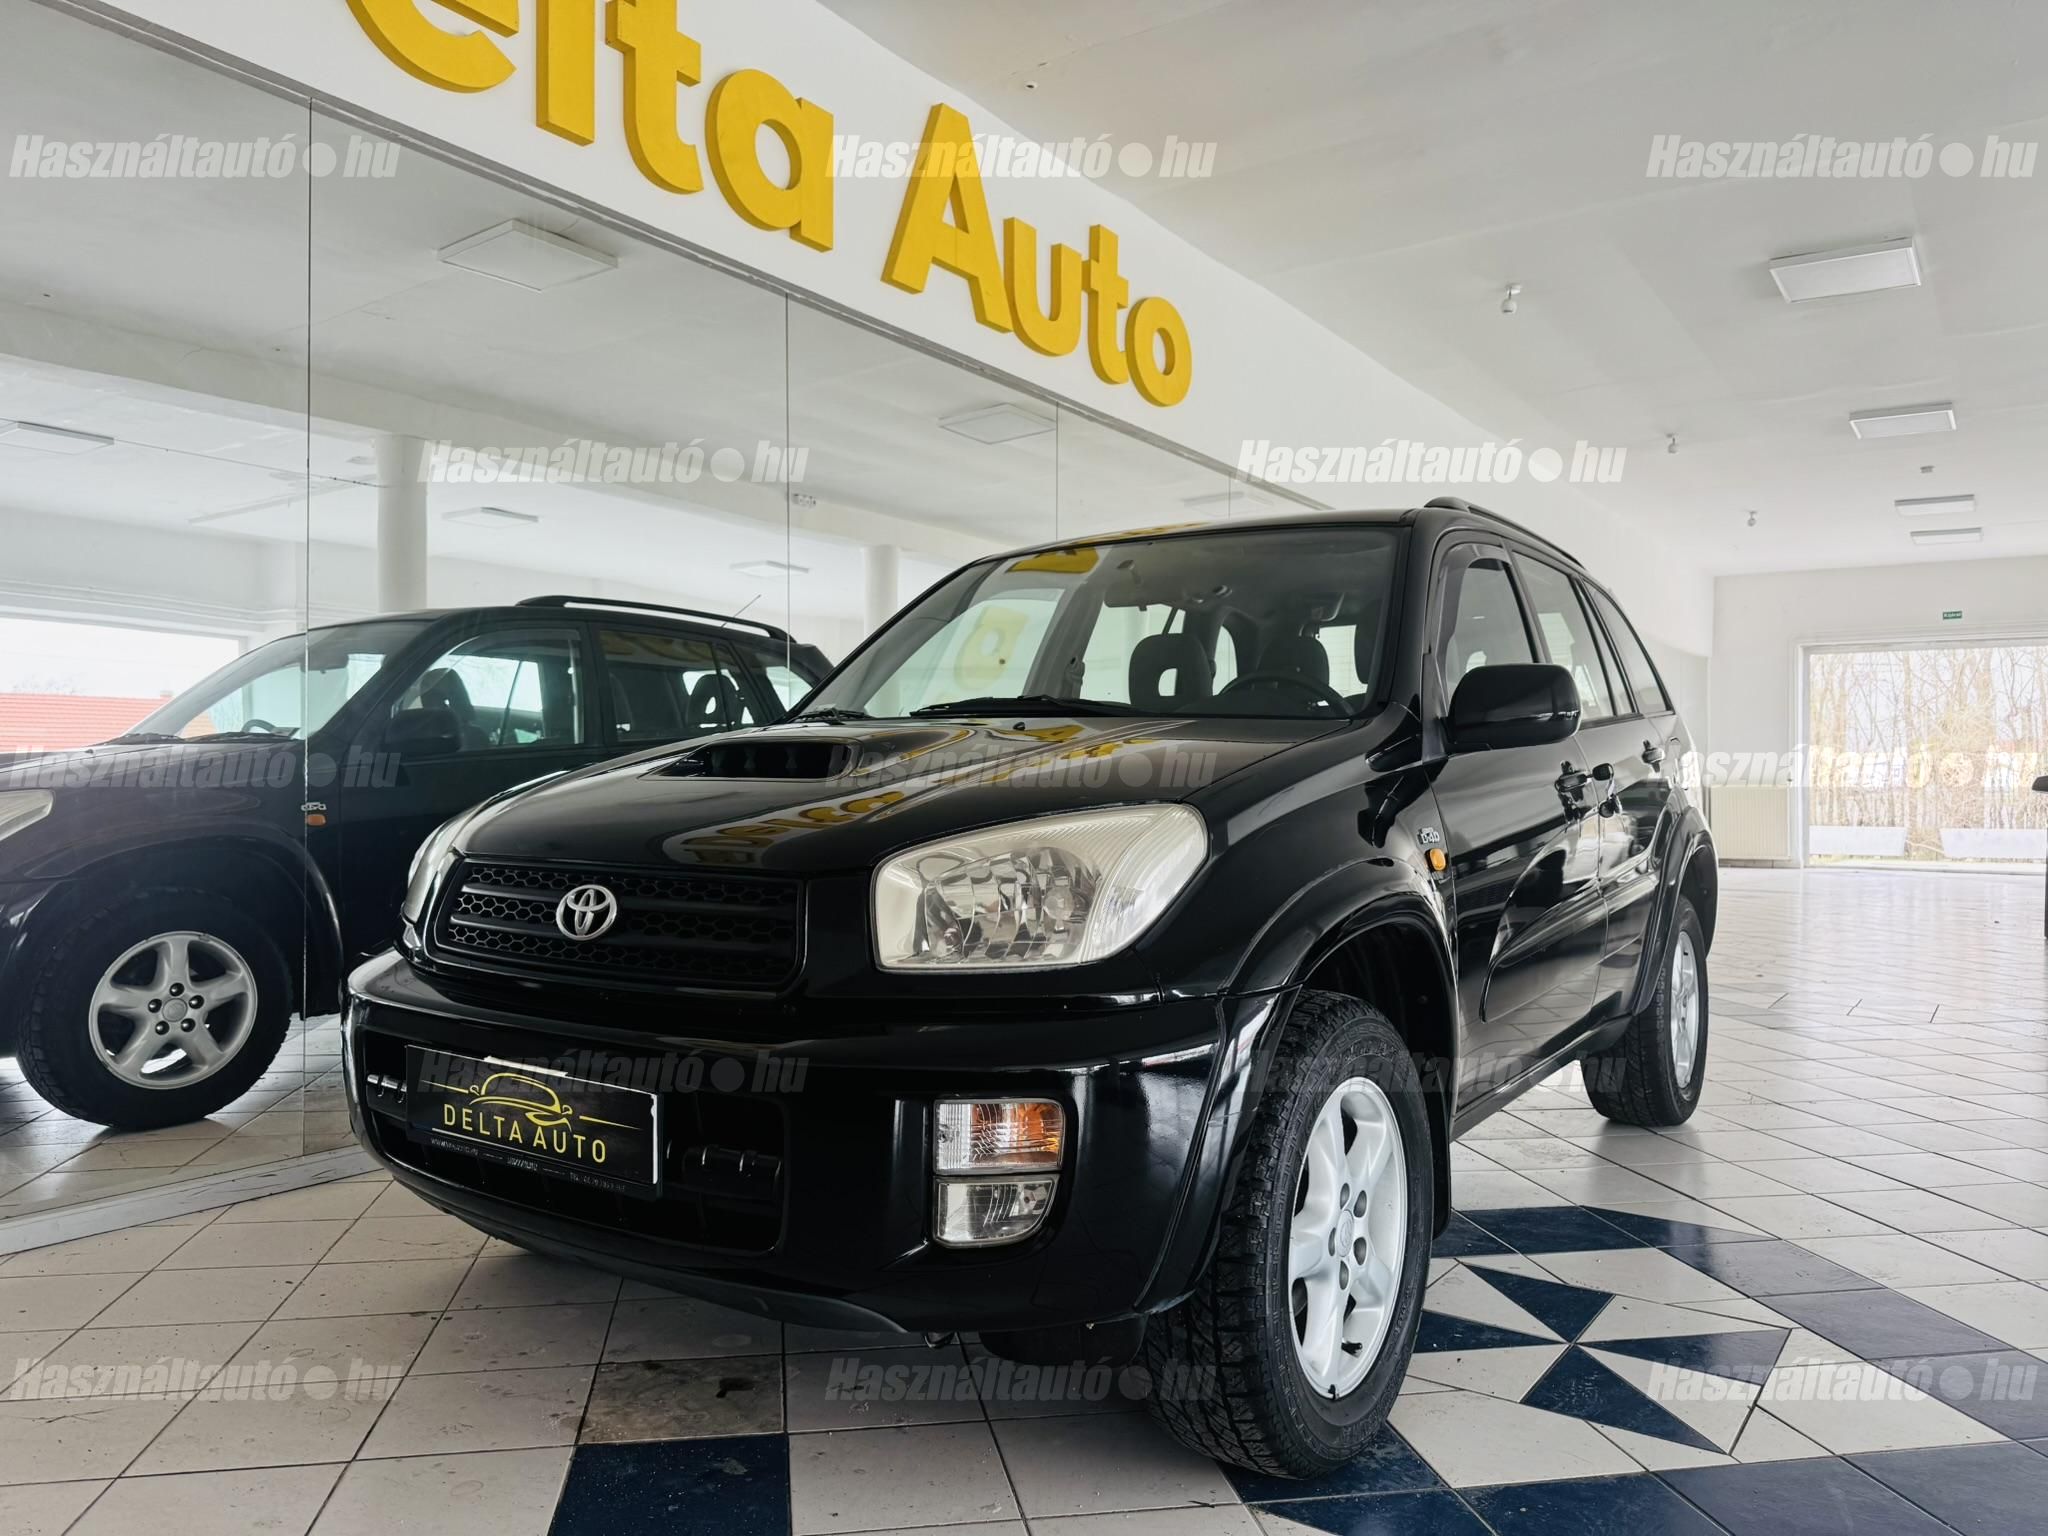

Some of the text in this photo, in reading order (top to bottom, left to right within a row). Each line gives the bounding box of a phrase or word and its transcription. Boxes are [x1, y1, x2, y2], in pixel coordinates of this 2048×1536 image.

[880, 102, 1192, 408] Auto
[443, 1103, 607, 1164] DELTA AUTO
